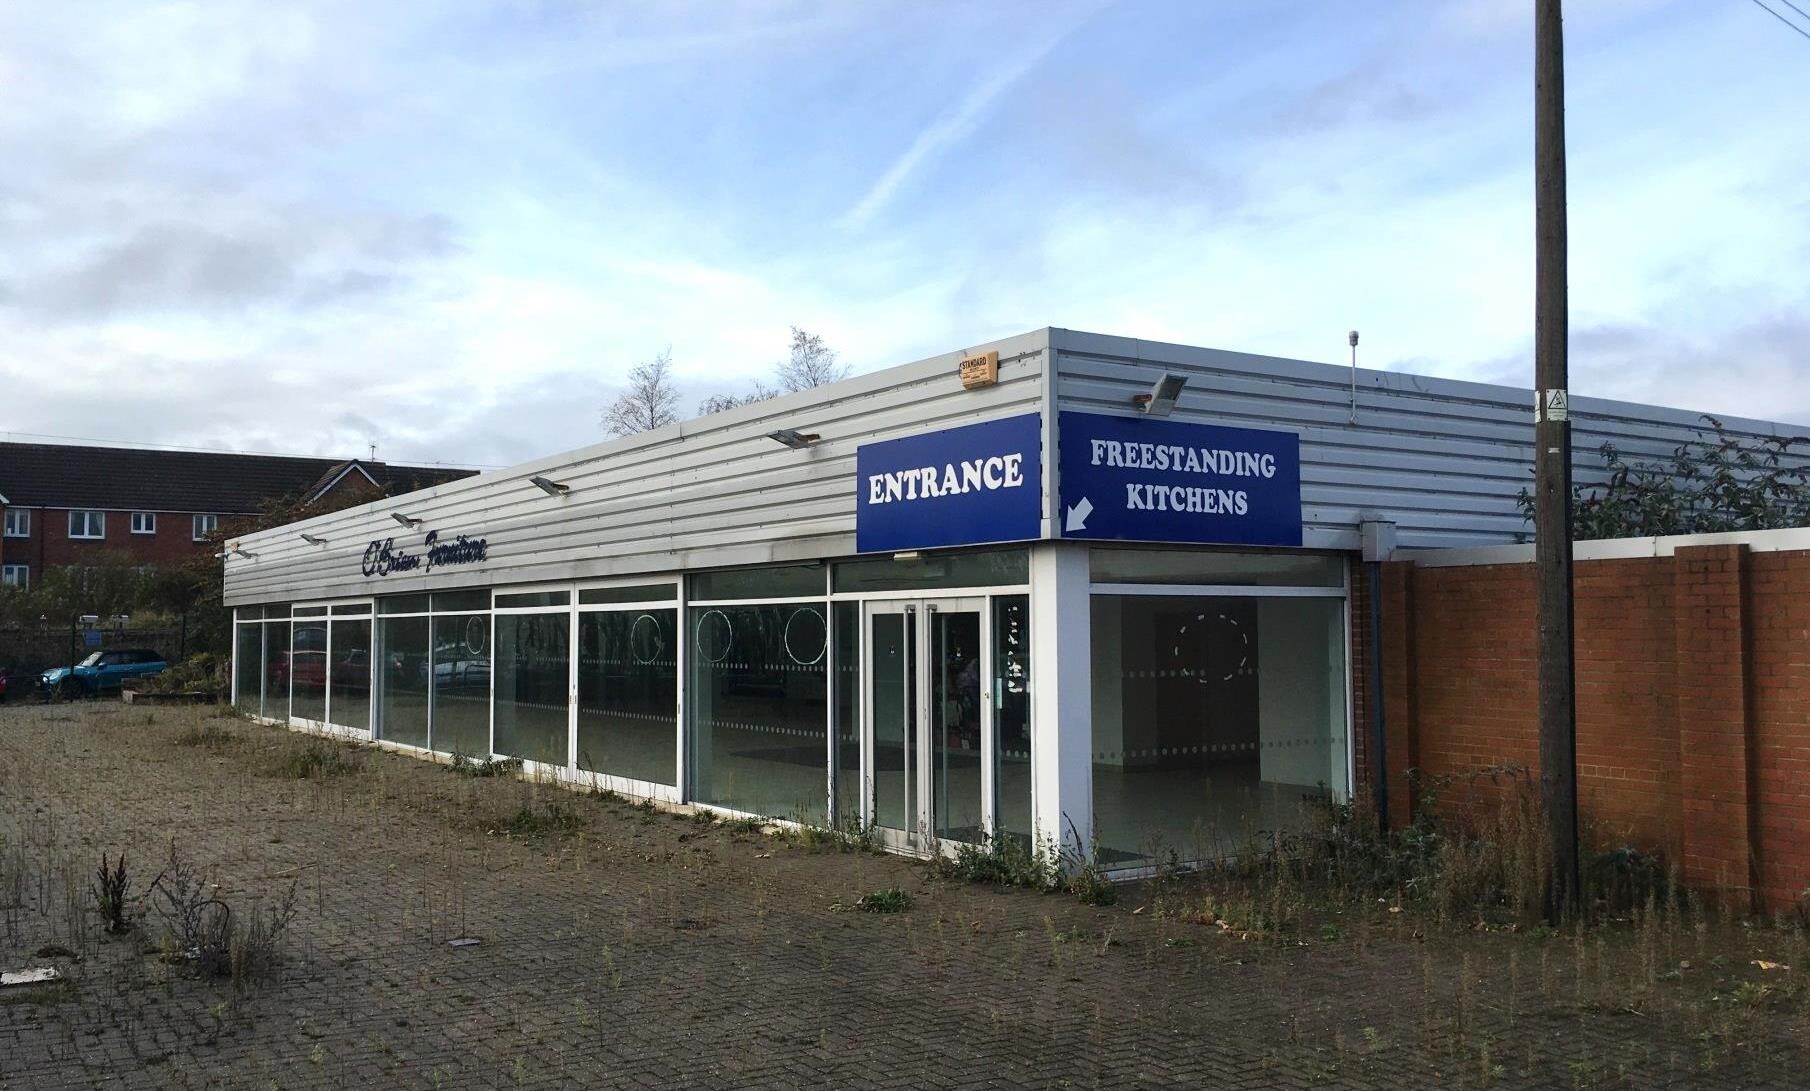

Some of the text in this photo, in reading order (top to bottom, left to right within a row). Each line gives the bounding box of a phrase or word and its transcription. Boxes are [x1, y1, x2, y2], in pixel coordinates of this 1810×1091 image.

[868, 452, 1023, 505] ENTRANCE
[1090, 439, 1276, 479] FREESTANDING
[1126, 483, 1248, 516] KITCHENS
